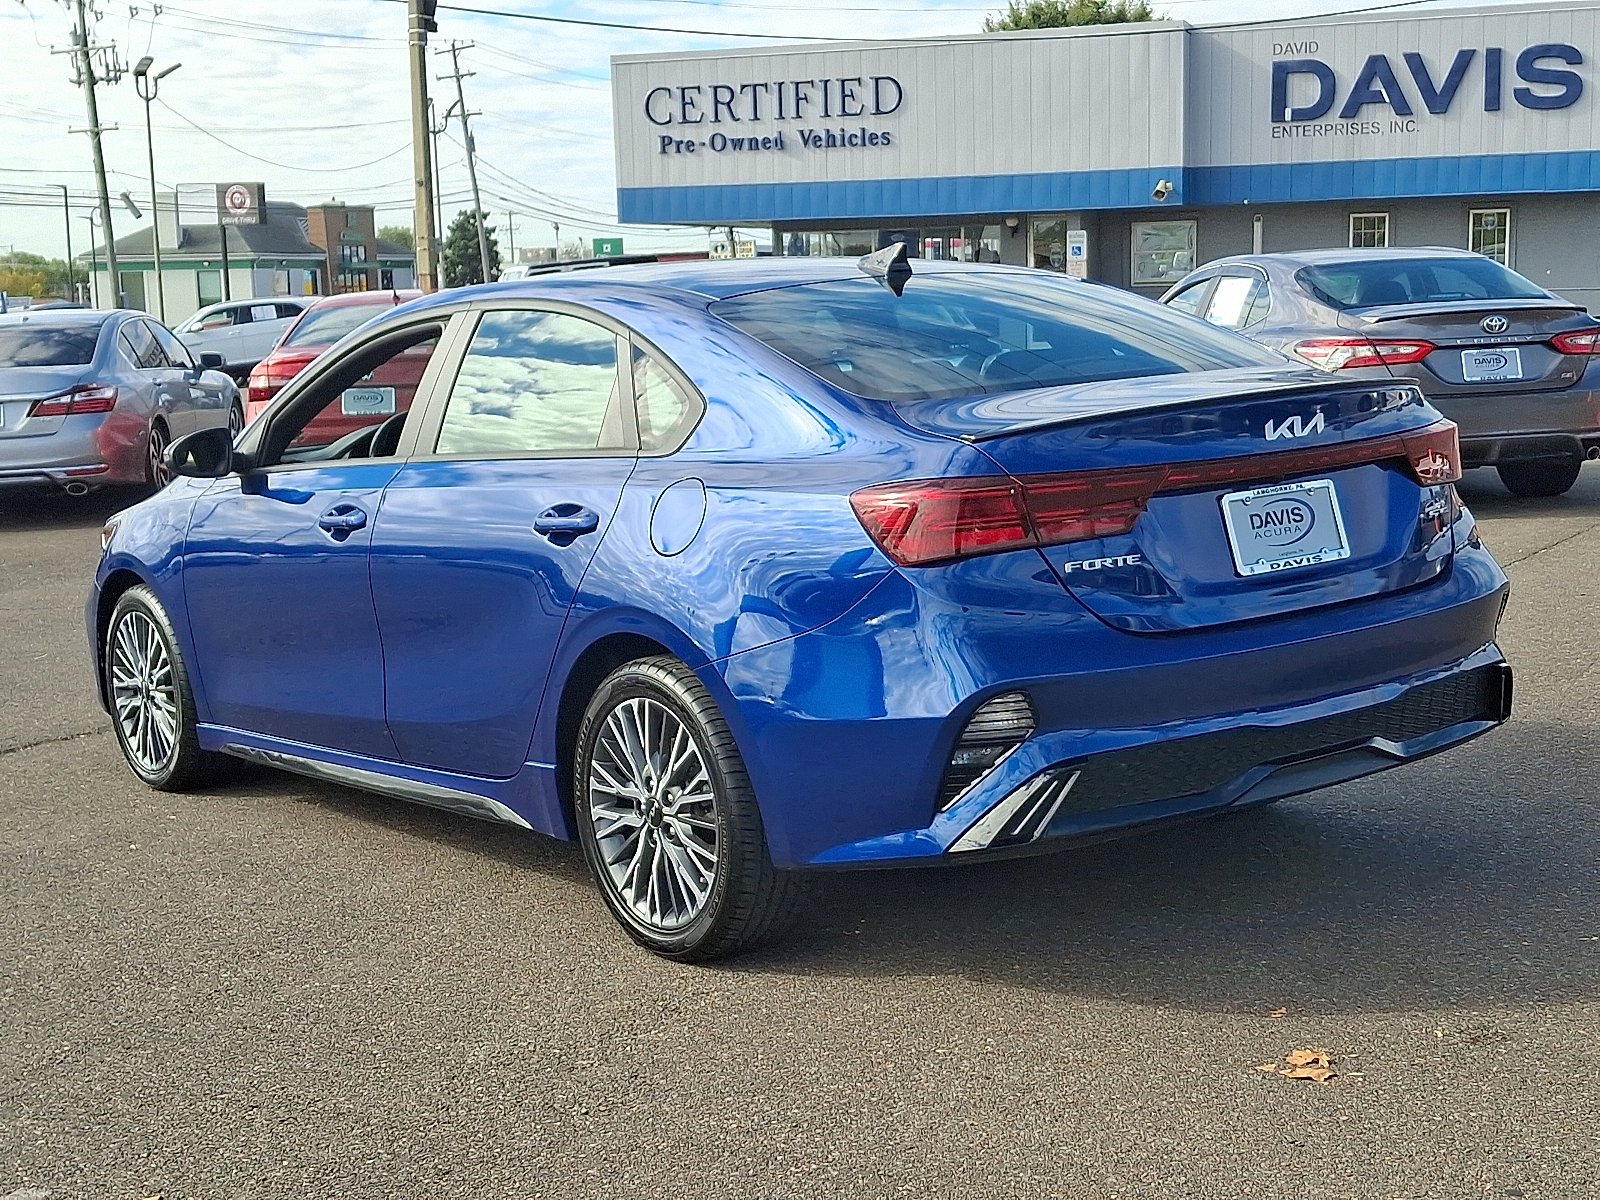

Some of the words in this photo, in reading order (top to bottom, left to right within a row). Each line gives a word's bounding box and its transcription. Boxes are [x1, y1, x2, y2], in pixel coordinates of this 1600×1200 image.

[1272, 40, 1319, 56] DAVID
[1271, 43, 1584, 123] DAVIS
[644, 75, 904, 126] CERTIFIED
[1271, 121, 1385, 139] ENTERPRISES,
[1389, 120, 1420, 134] INC.
[659, 131, 784, 155] Pre-Owned
[798, 127, 891, 149] Vehicles
[1474, 357, 1502, 365] DAVIS
[1249, 507, 1304, 530] DAVIS
[1254, 525, 1303, 540] ACURA
[1064, 554, 1142, 574] FORTE
[1270, 555, 1323, 570] DAVIS
